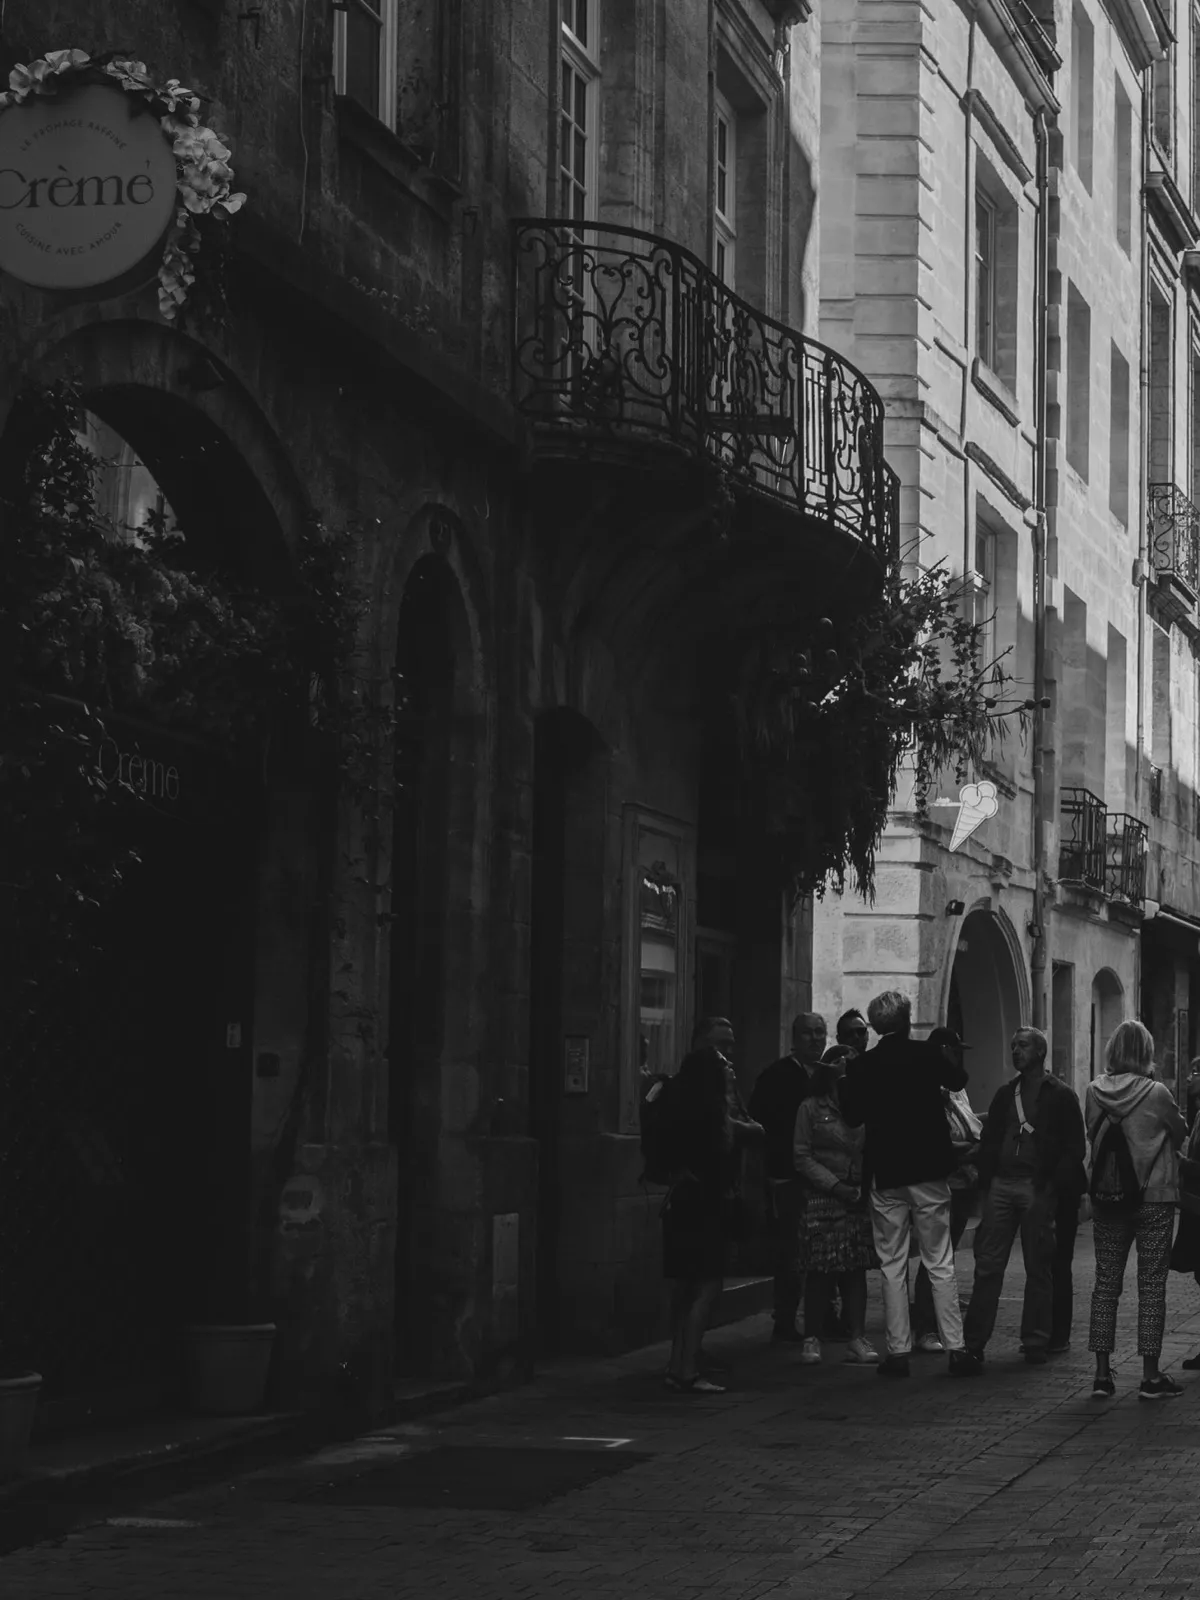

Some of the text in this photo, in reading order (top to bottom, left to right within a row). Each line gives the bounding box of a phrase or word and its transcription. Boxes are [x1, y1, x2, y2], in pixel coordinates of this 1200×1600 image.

[15, 221, 123, 256] CUISINE AVEC AMOUR
